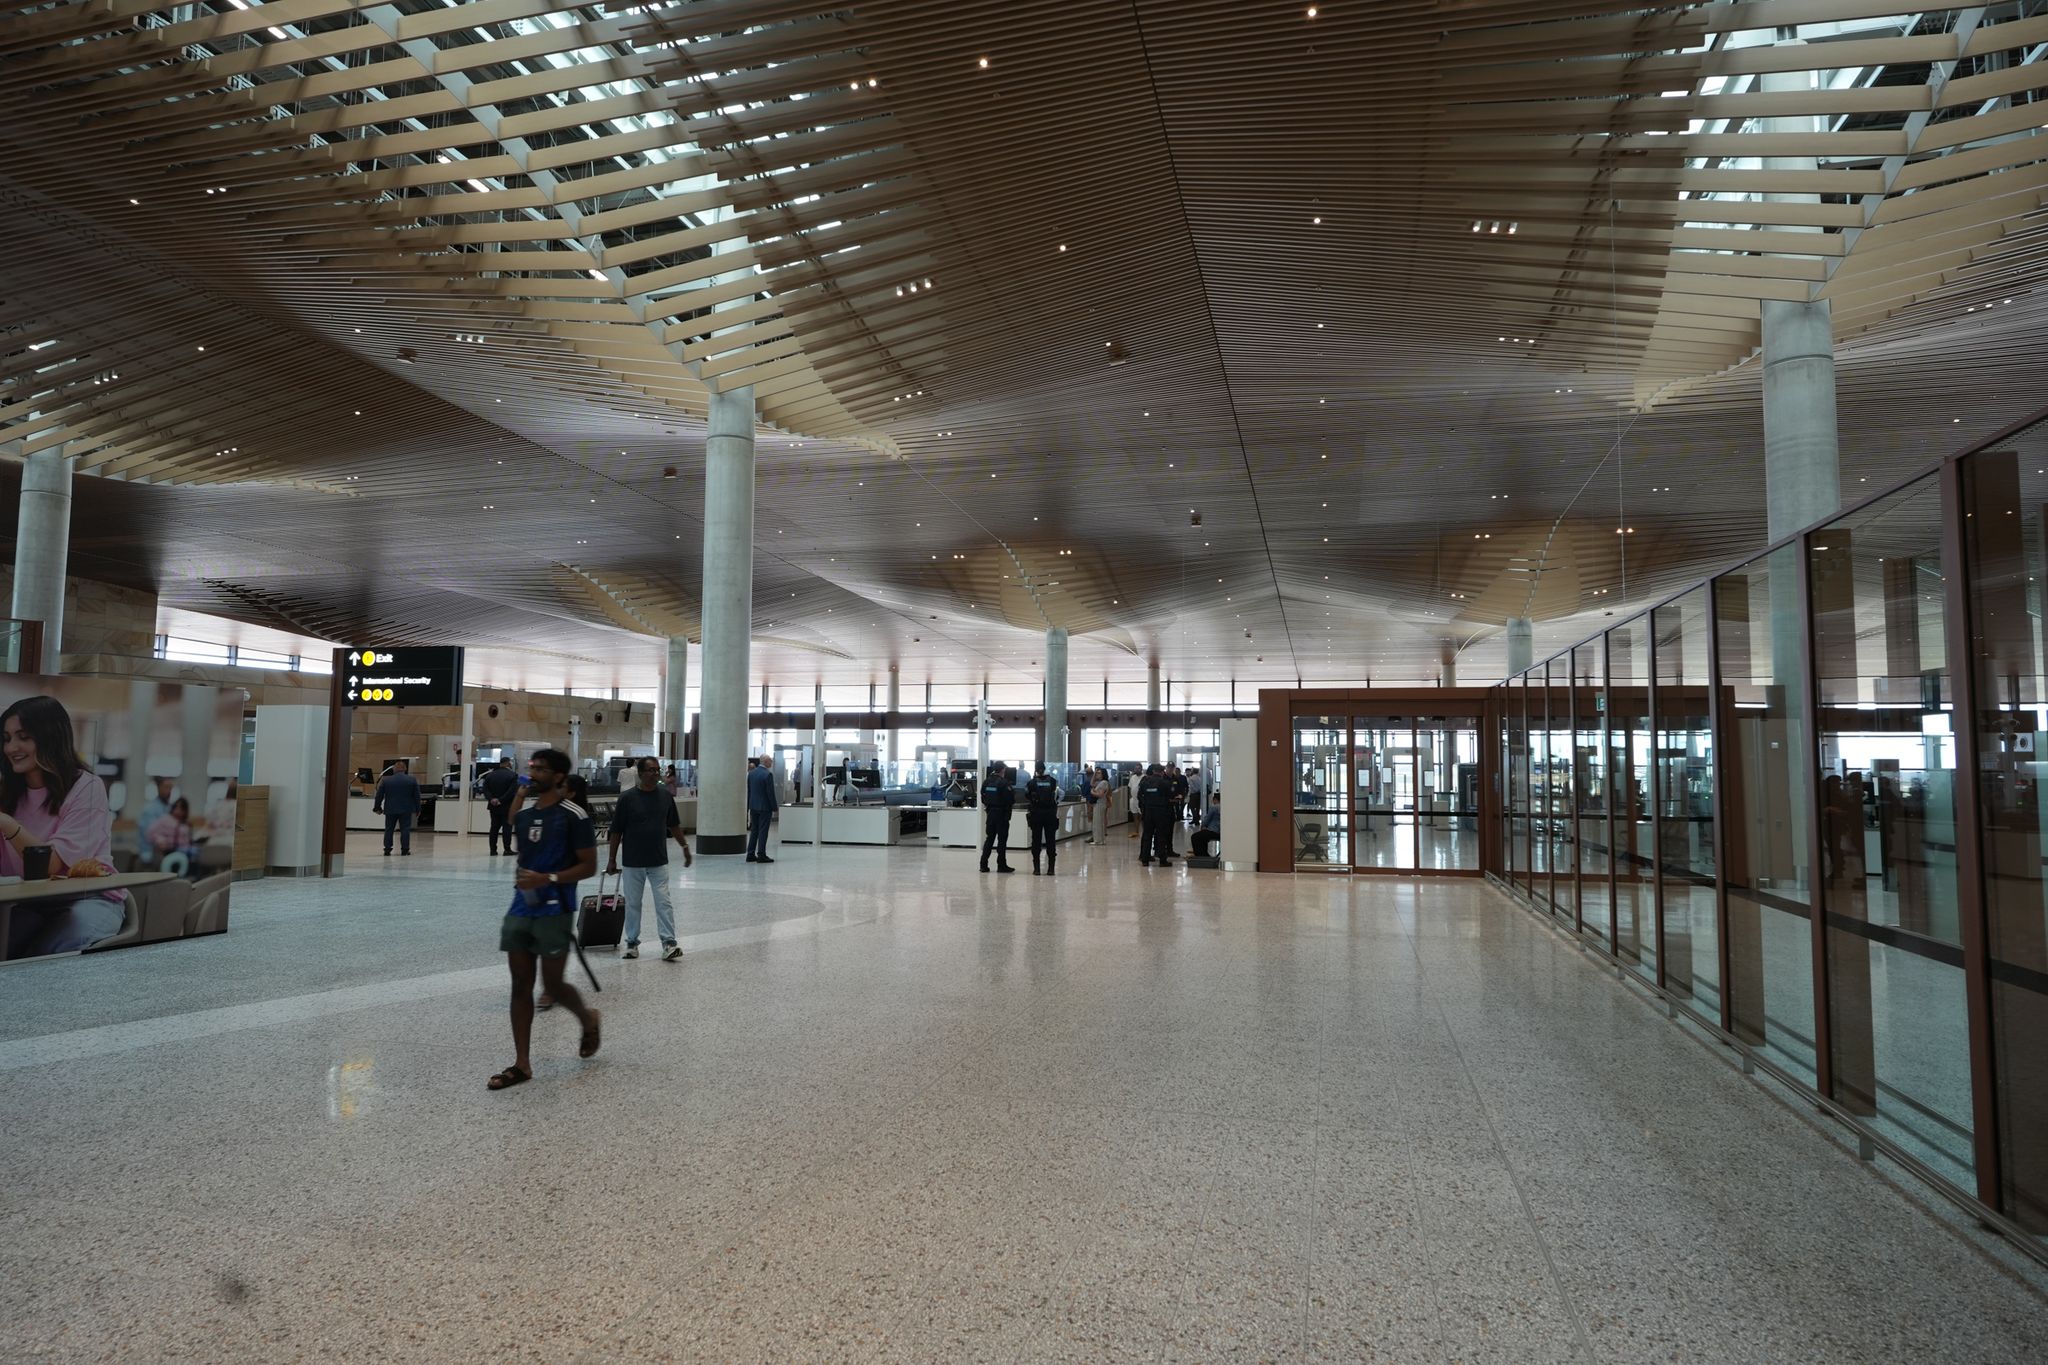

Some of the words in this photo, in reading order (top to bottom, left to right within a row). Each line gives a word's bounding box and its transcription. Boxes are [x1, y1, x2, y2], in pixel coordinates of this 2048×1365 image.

[376, 654, 393, 663] Exit
[362, 677, 403, 685] International
[404, 677, 431, 685] Security
